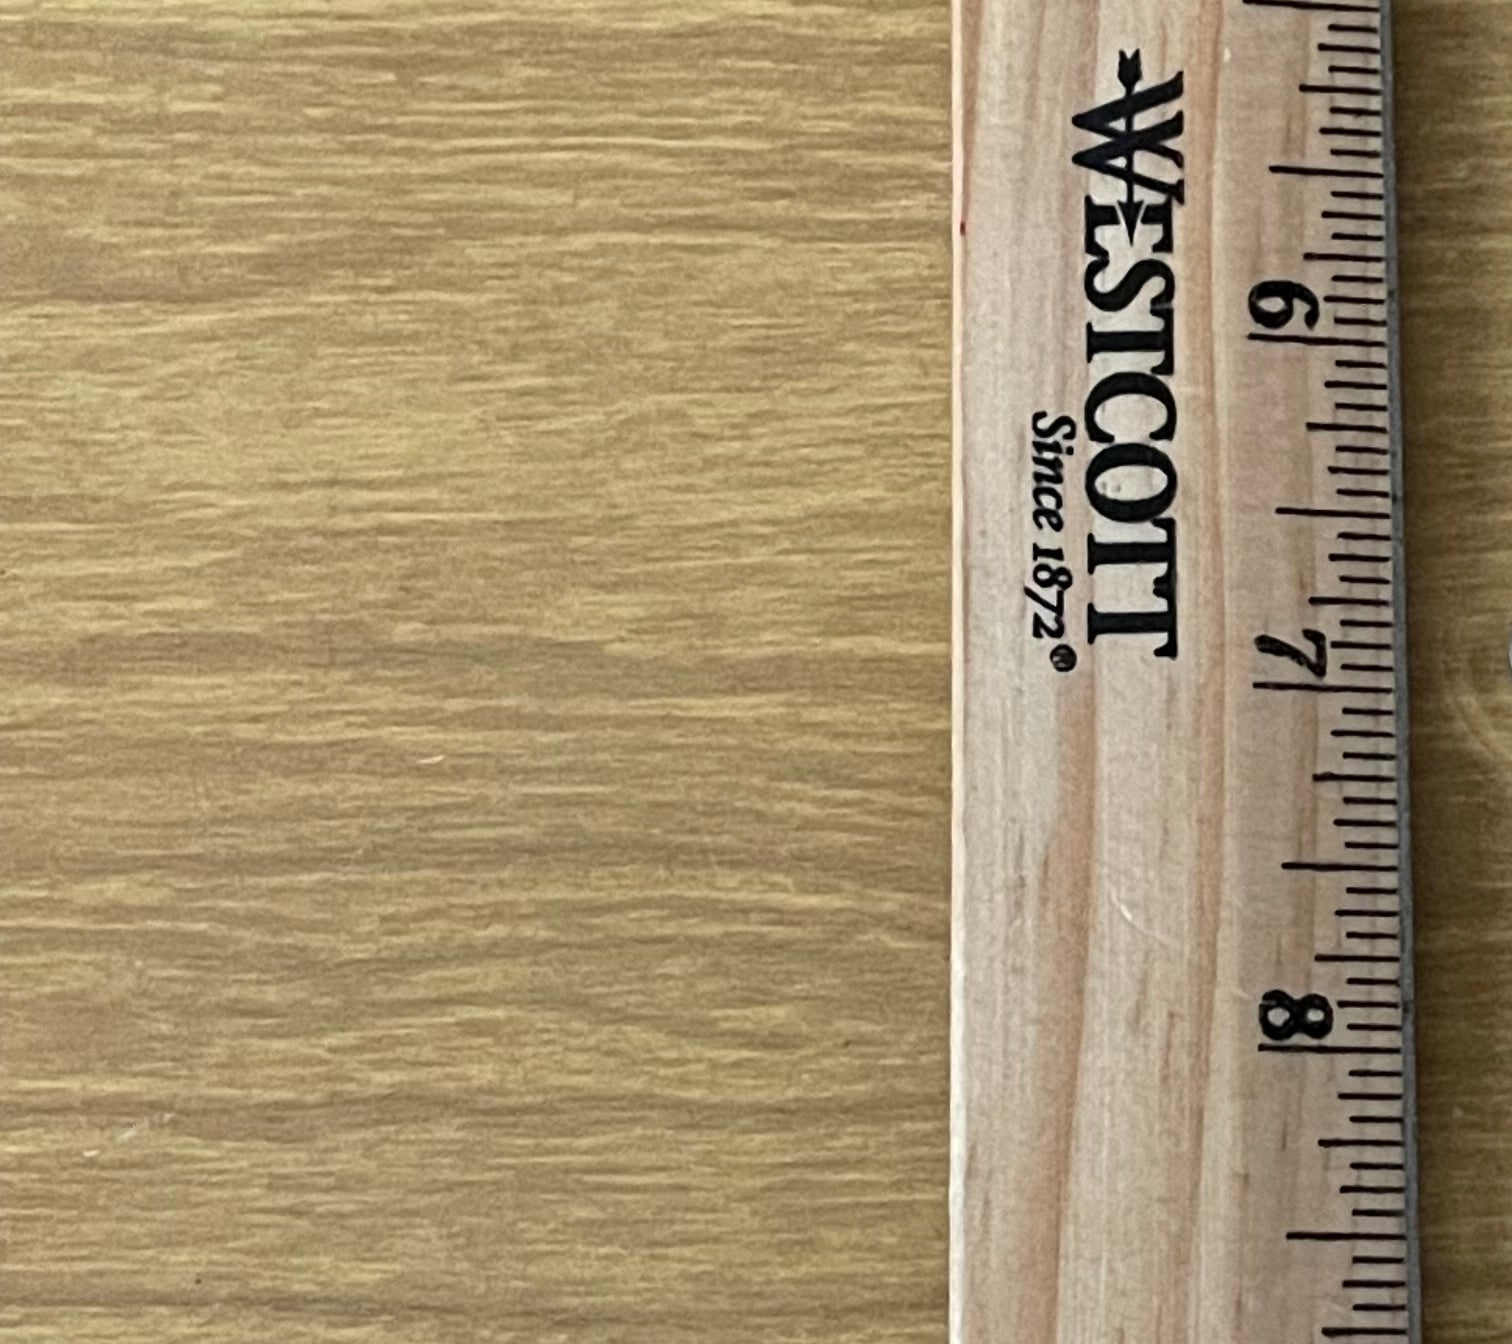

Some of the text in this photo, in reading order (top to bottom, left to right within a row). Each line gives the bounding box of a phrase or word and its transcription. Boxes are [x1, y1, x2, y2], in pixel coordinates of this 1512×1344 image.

[1247, 279, 1320, 331] 6
[1071, 67, 1184, 661] WESTCOTT
[1031, 410, 1077, 533] Since
[1253, 627, 1328, 680] 7
[1258, 988, 1334, 1042] 8
